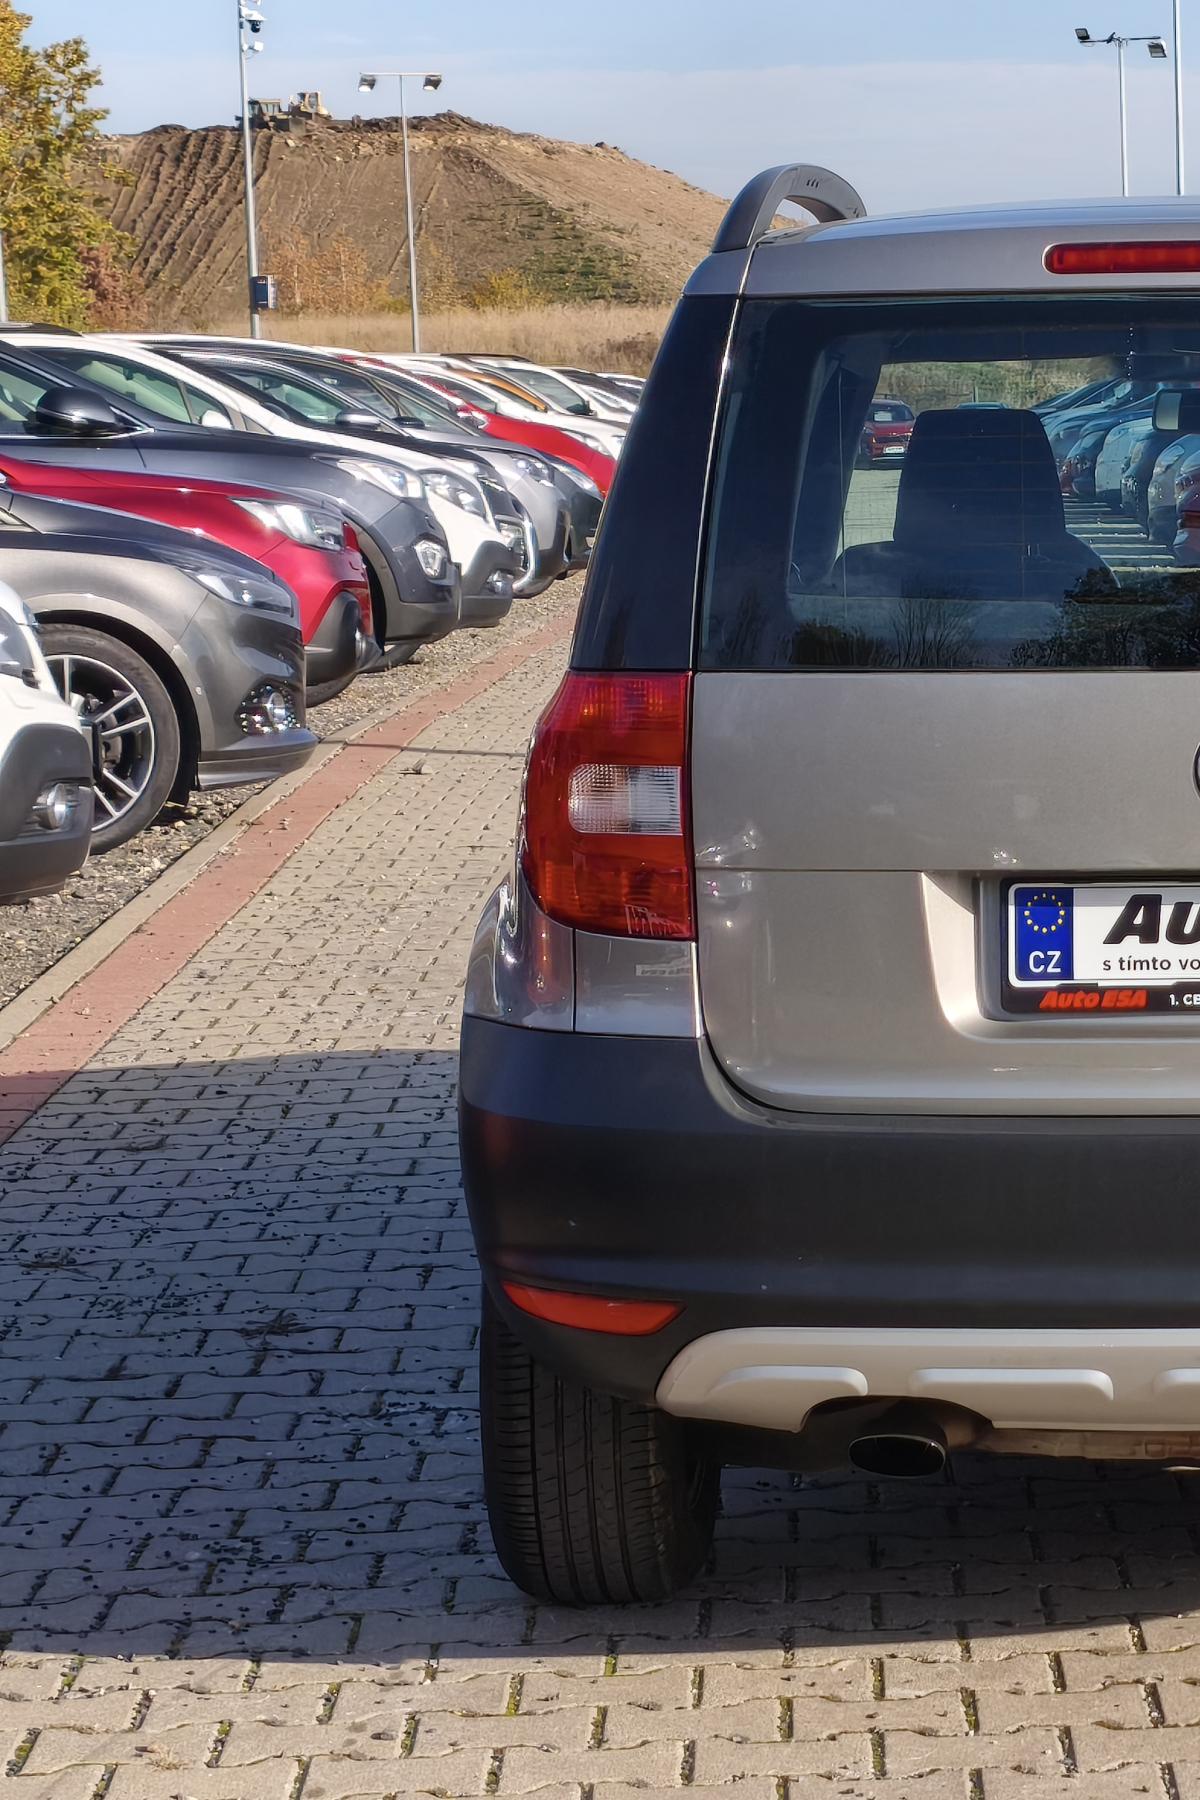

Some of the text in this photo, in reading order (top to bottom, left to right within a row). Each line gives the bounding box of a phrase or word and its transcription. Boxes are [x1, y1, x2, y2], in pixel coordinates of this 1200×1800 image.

[1028, 950, 1062, 973] CZ
[1103, 960, 1111, 971] s
[1119, 955, 1171, 971] tímto
[1040, 990, 1147, 1009] Auto ESA
